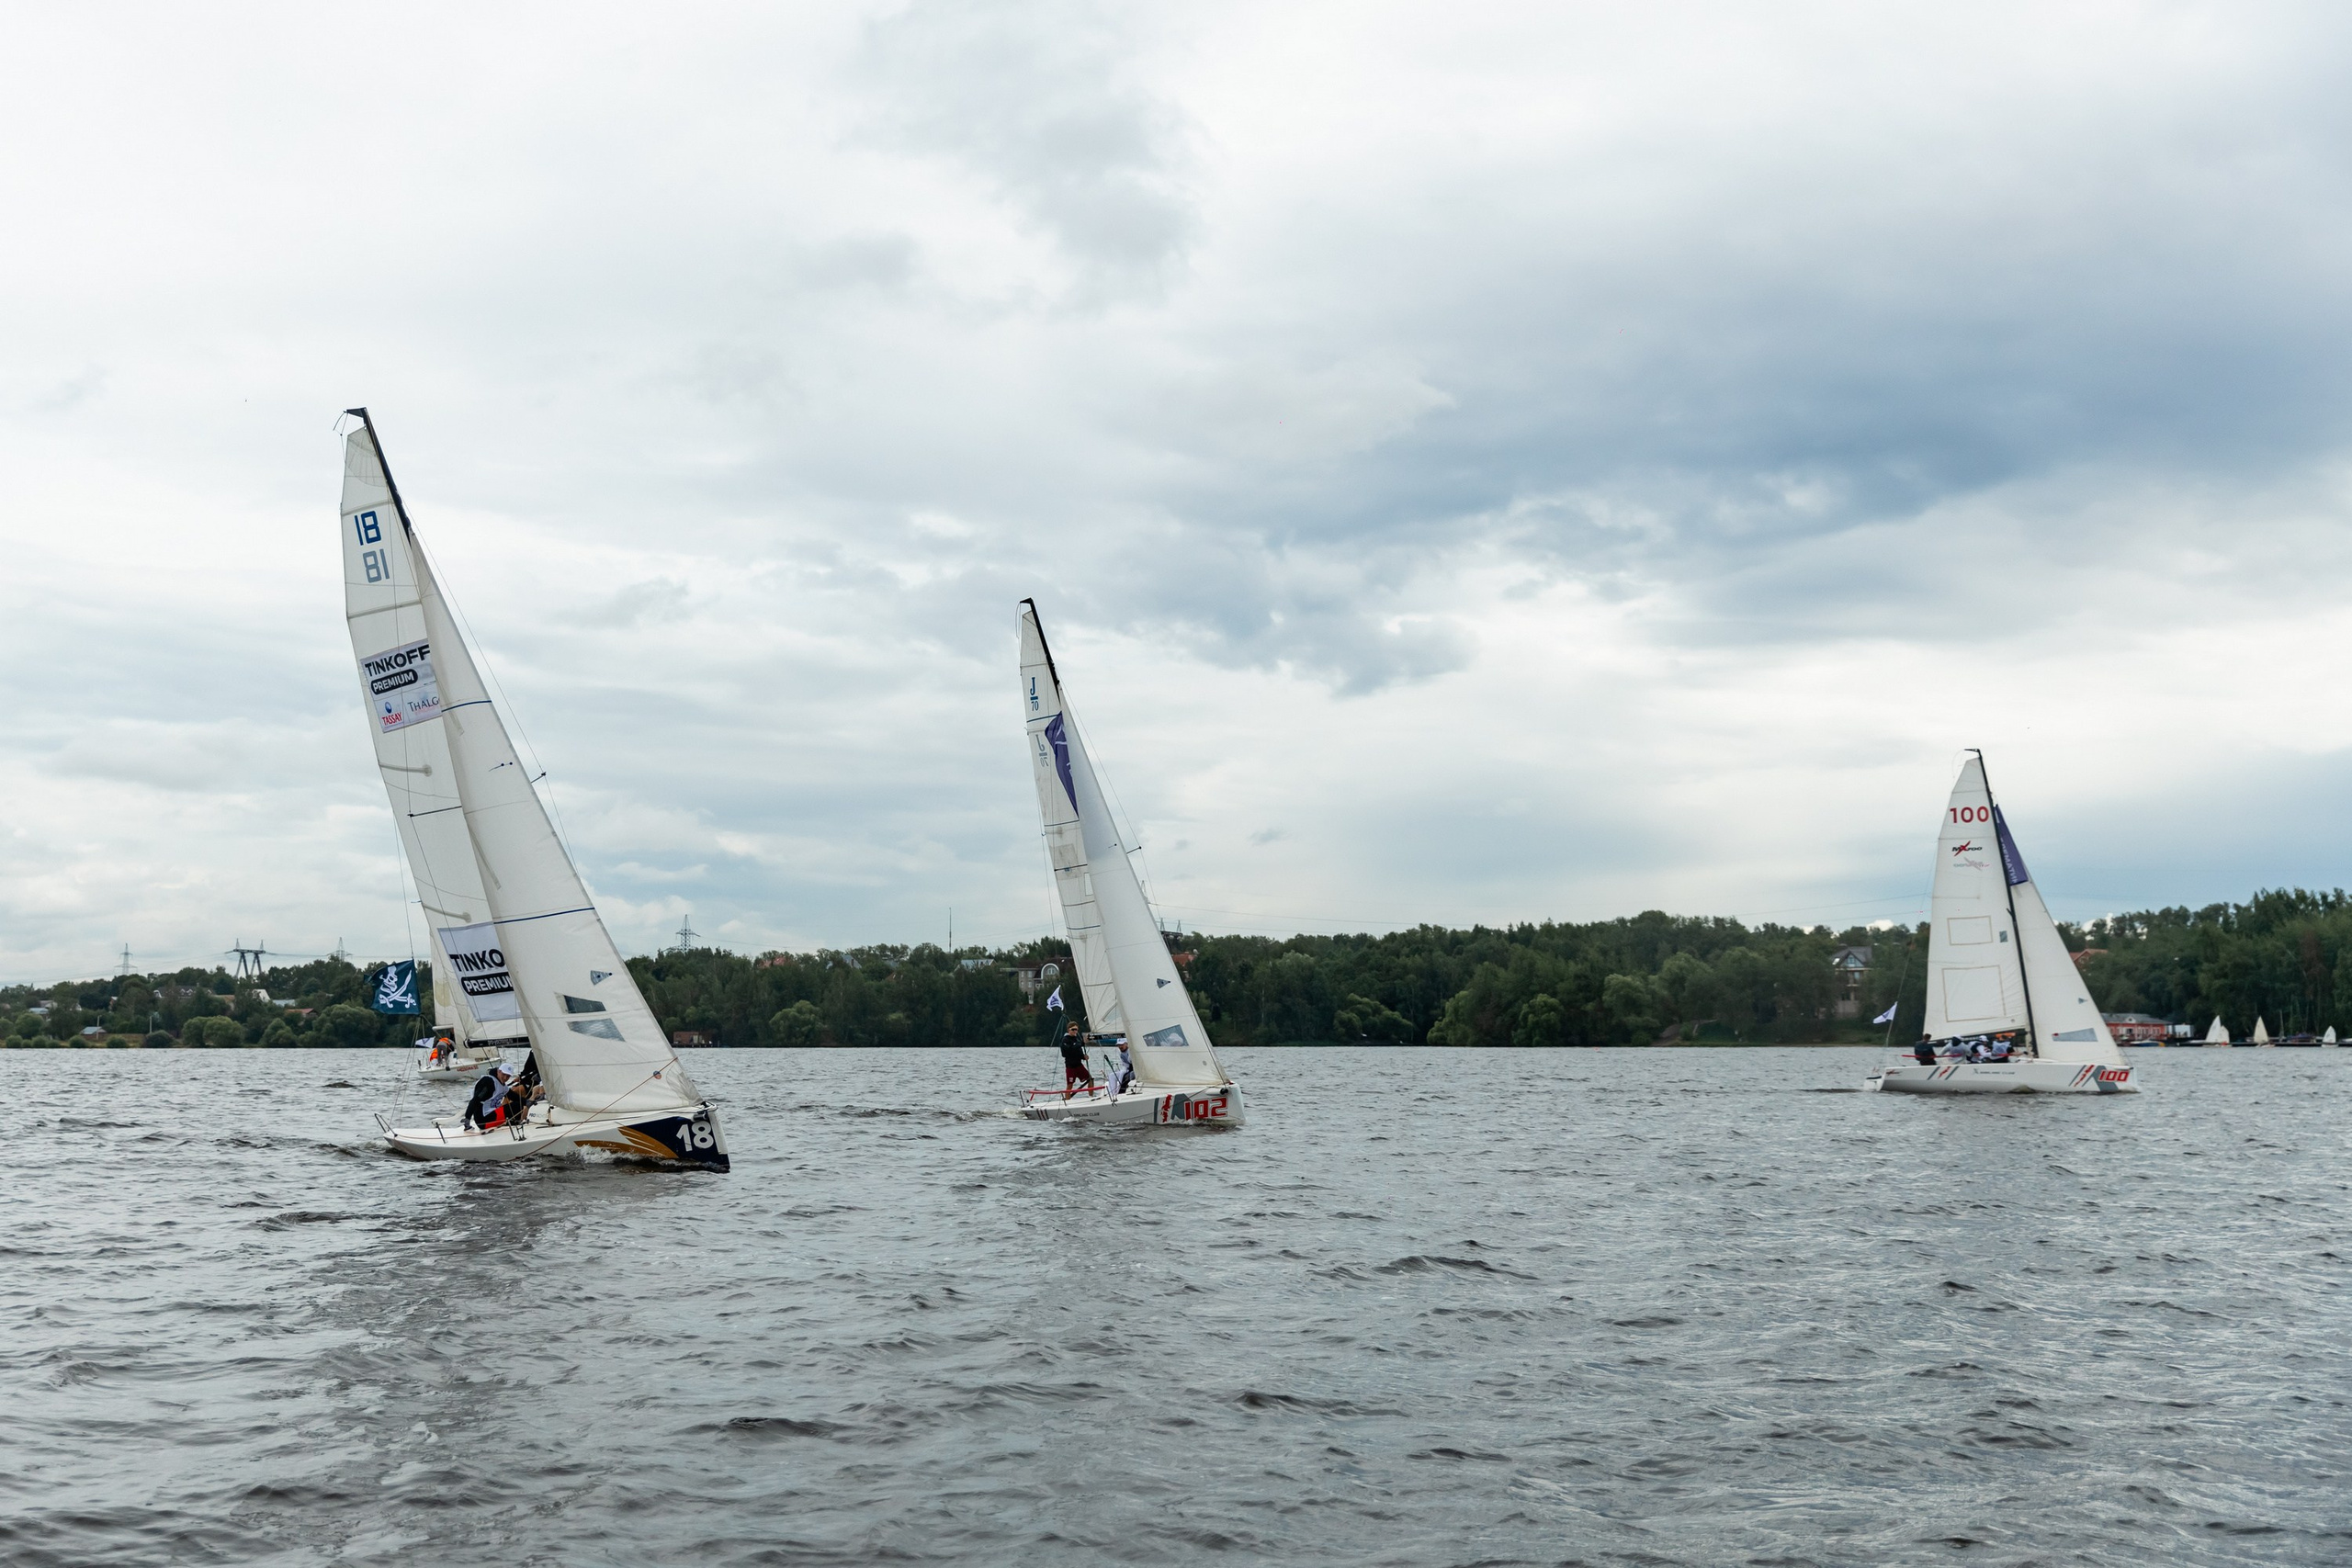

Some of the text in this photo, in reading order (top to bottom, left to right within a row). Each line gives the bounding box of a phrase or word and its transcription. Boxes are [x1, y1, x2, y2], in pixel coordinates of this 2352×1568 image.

[354, 511, 381, 546] 18
[365, 644, 430, 676] TINKOFF
[372, 671, 414, 692] PREMIUM
[382, 712, 402, 726] TASSAY
[1950, 807, 1989, 823] 100
[2098, 1069, 2130, 1082] 100
[1184, 1097, 1227, 1120] 102
[676, 1121, 714, 1152] 18
